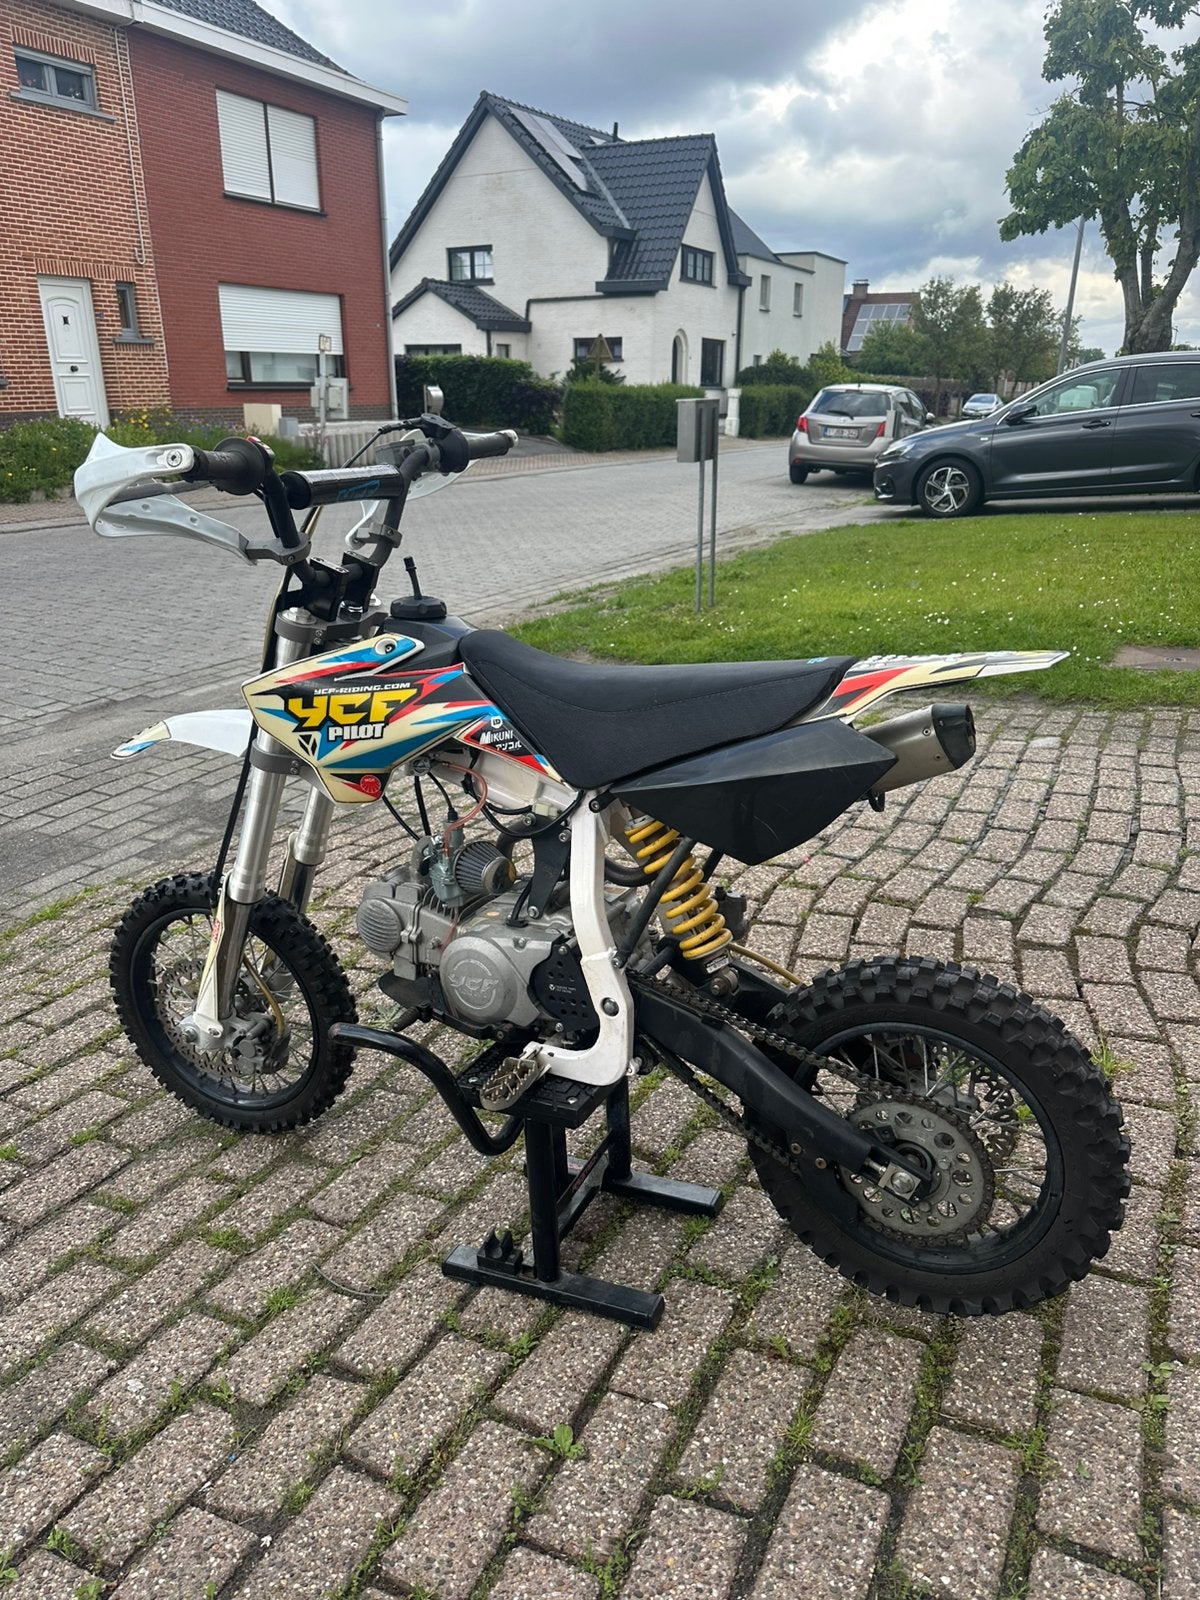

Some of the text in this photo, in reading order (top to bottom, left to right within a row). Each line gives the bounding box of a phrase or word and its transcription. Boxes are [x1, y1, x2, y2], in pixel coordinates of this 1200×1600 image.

[314, 682, 411, 695] YCF-RIDING.COM
[288, 688, 418, 728] YCF
[328, 723, 385, 741] PILOT
[480, 729, 514, 745] MIKUNI
